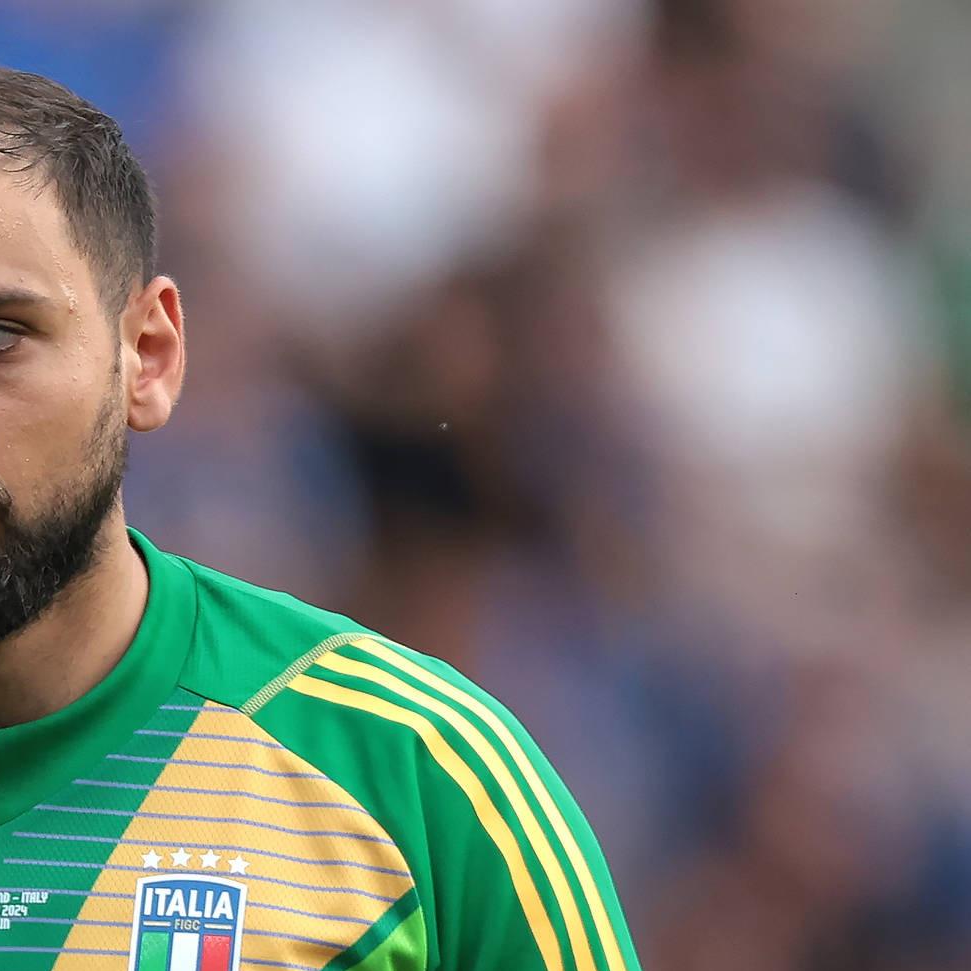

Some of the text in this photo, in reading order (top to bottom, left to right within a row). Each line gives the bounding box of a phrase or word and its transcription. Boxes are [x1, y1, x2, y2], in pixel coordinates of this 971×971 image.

[21, 891, 49, 904] ITALY
[143, 887, 234, 920] ITALIA
[1, 904, 28, 917] 2024
[174, 918, 202, 932] FIGC
